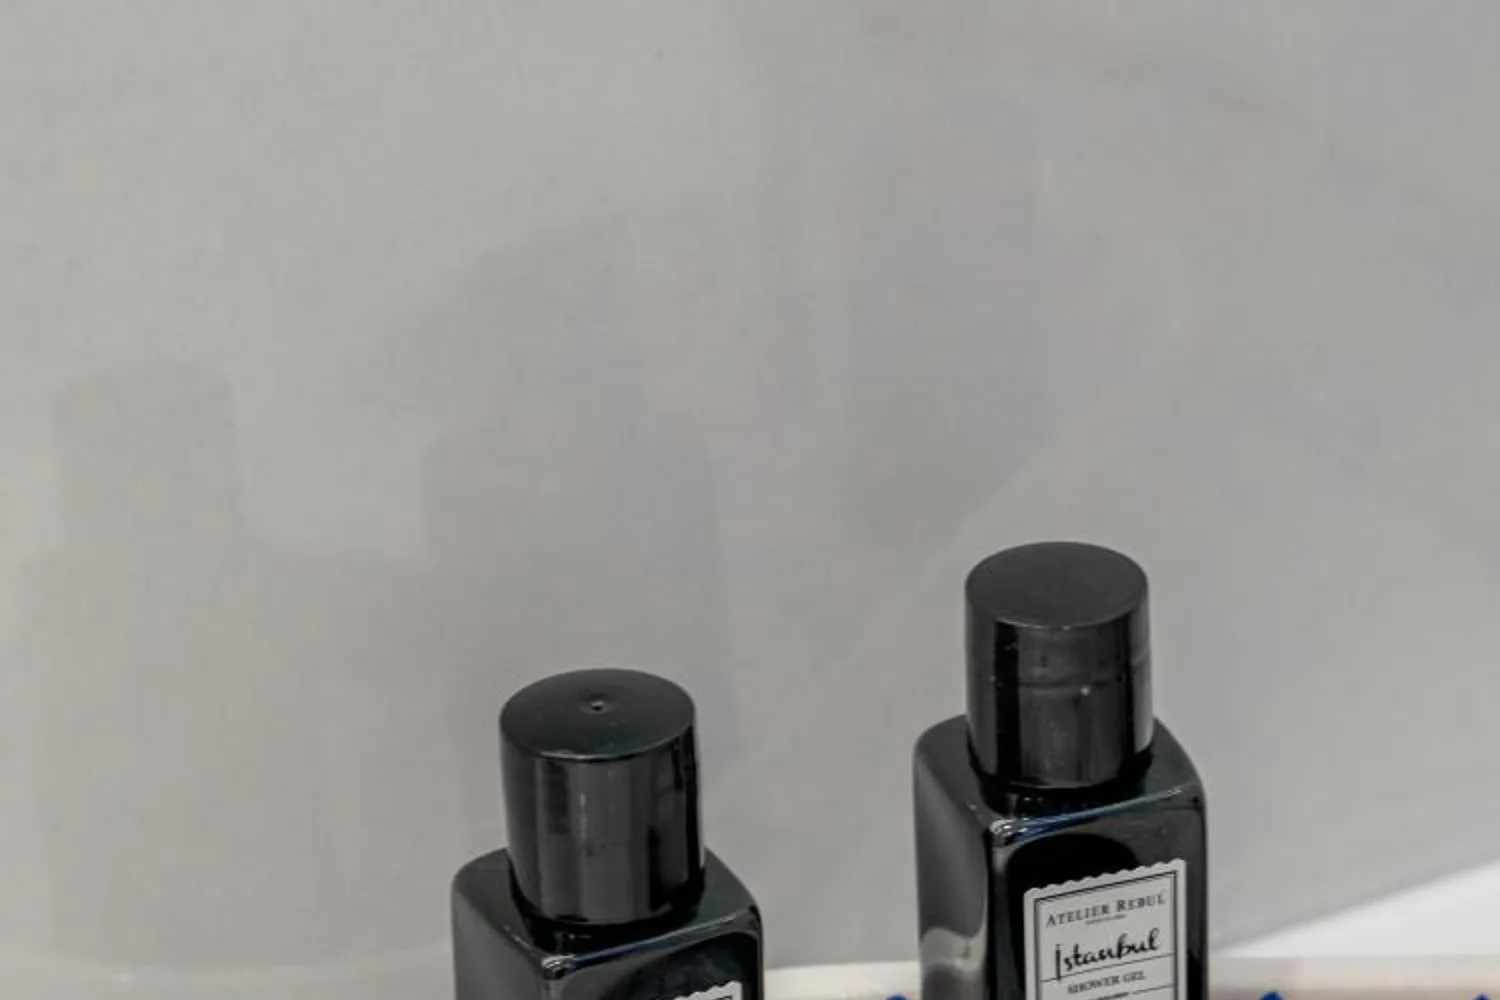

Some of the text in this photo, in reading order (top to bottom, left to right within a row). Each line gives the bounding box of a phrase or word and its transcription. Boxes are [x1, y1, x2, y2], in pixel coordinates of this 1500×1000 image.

[1046, 904, 1109, 928] ATELIER
[1116, 893, 1166, 912] REBUL
[1067, 971, 1146, 994] SHOWER GEL
